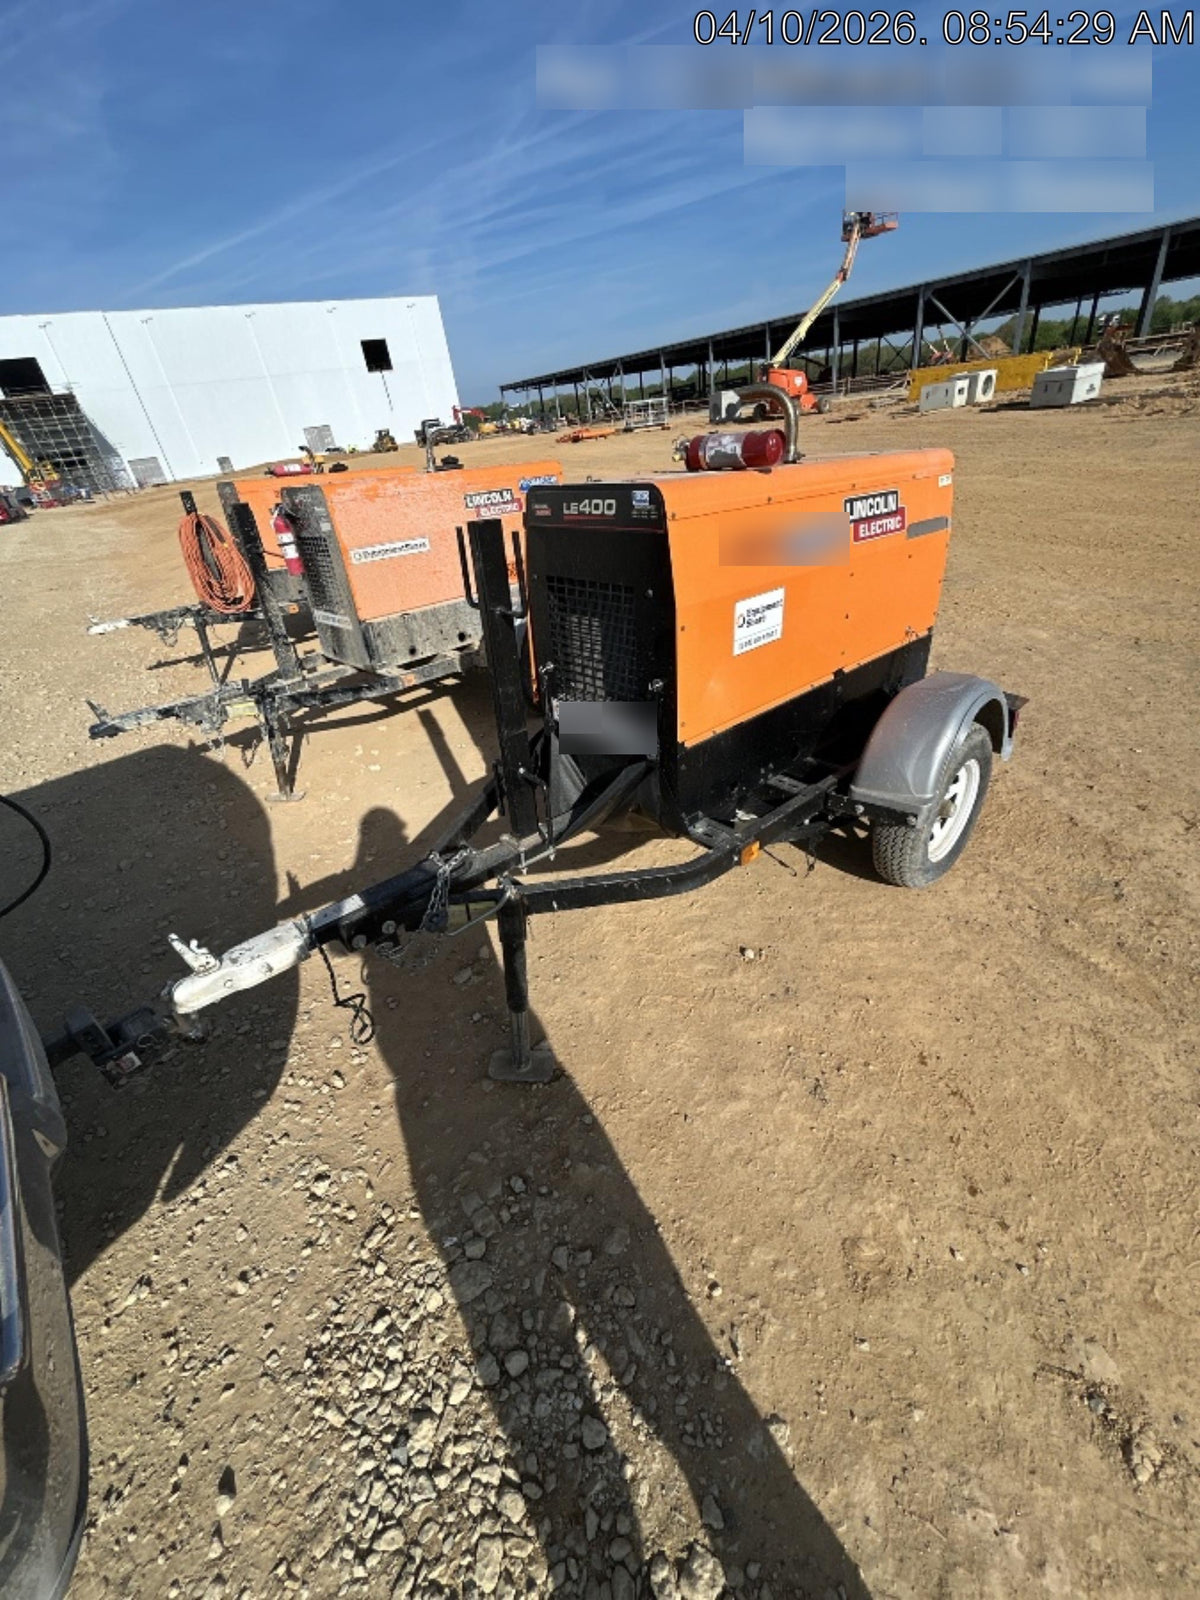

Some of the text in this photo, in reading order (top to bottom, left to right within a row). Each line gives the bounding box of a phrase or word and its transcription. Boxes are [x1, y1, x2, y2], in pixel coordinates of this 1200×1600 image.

[466, 490, 513, 508] LINCOLN
[563, 499, 616, 515] LE400
[846, 493, 897, 521] LINCOLN
[860, 516, 902, 538] ELECTRIC
